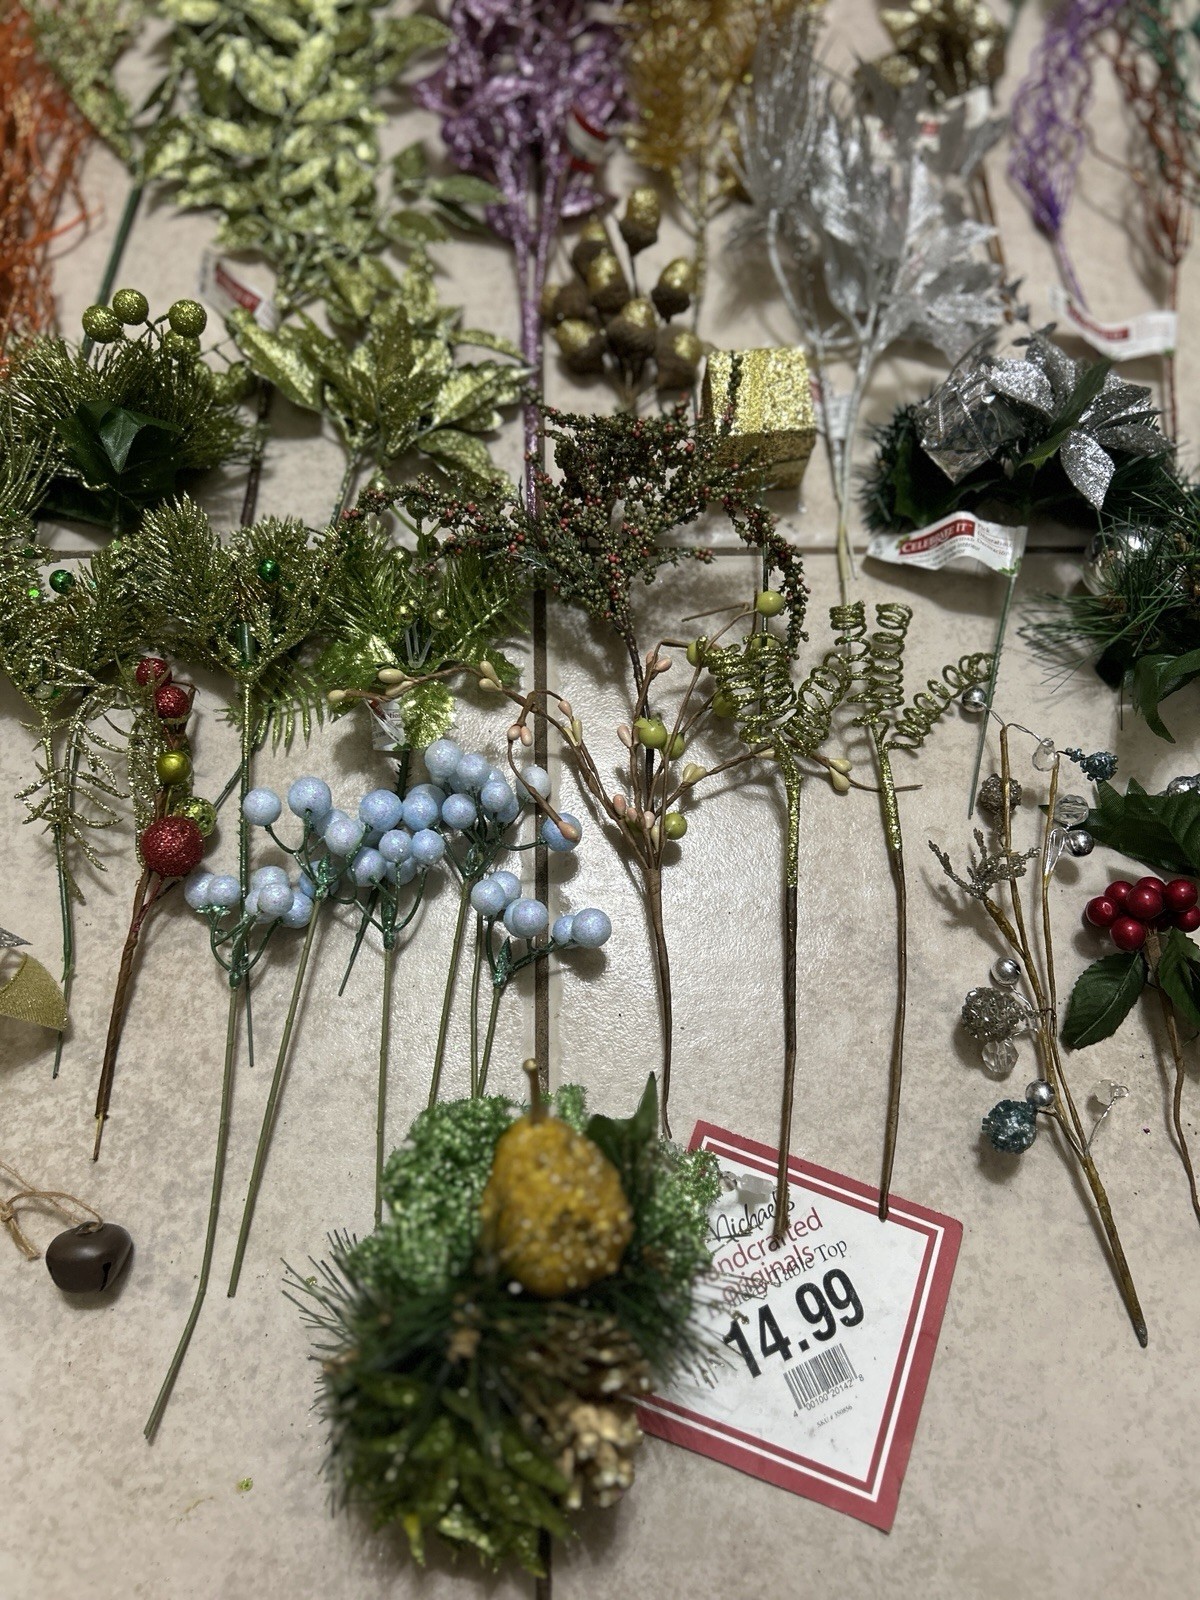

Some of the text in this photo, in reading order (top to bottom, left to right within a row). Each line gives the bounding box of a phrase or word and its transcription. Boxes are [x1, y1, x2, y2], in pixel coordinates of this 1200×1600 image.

[814, 1240, 847, 1262] Top
[723, 1268, 864, 1378] 14.99
[830, 1379, 853, 1398] 20142
